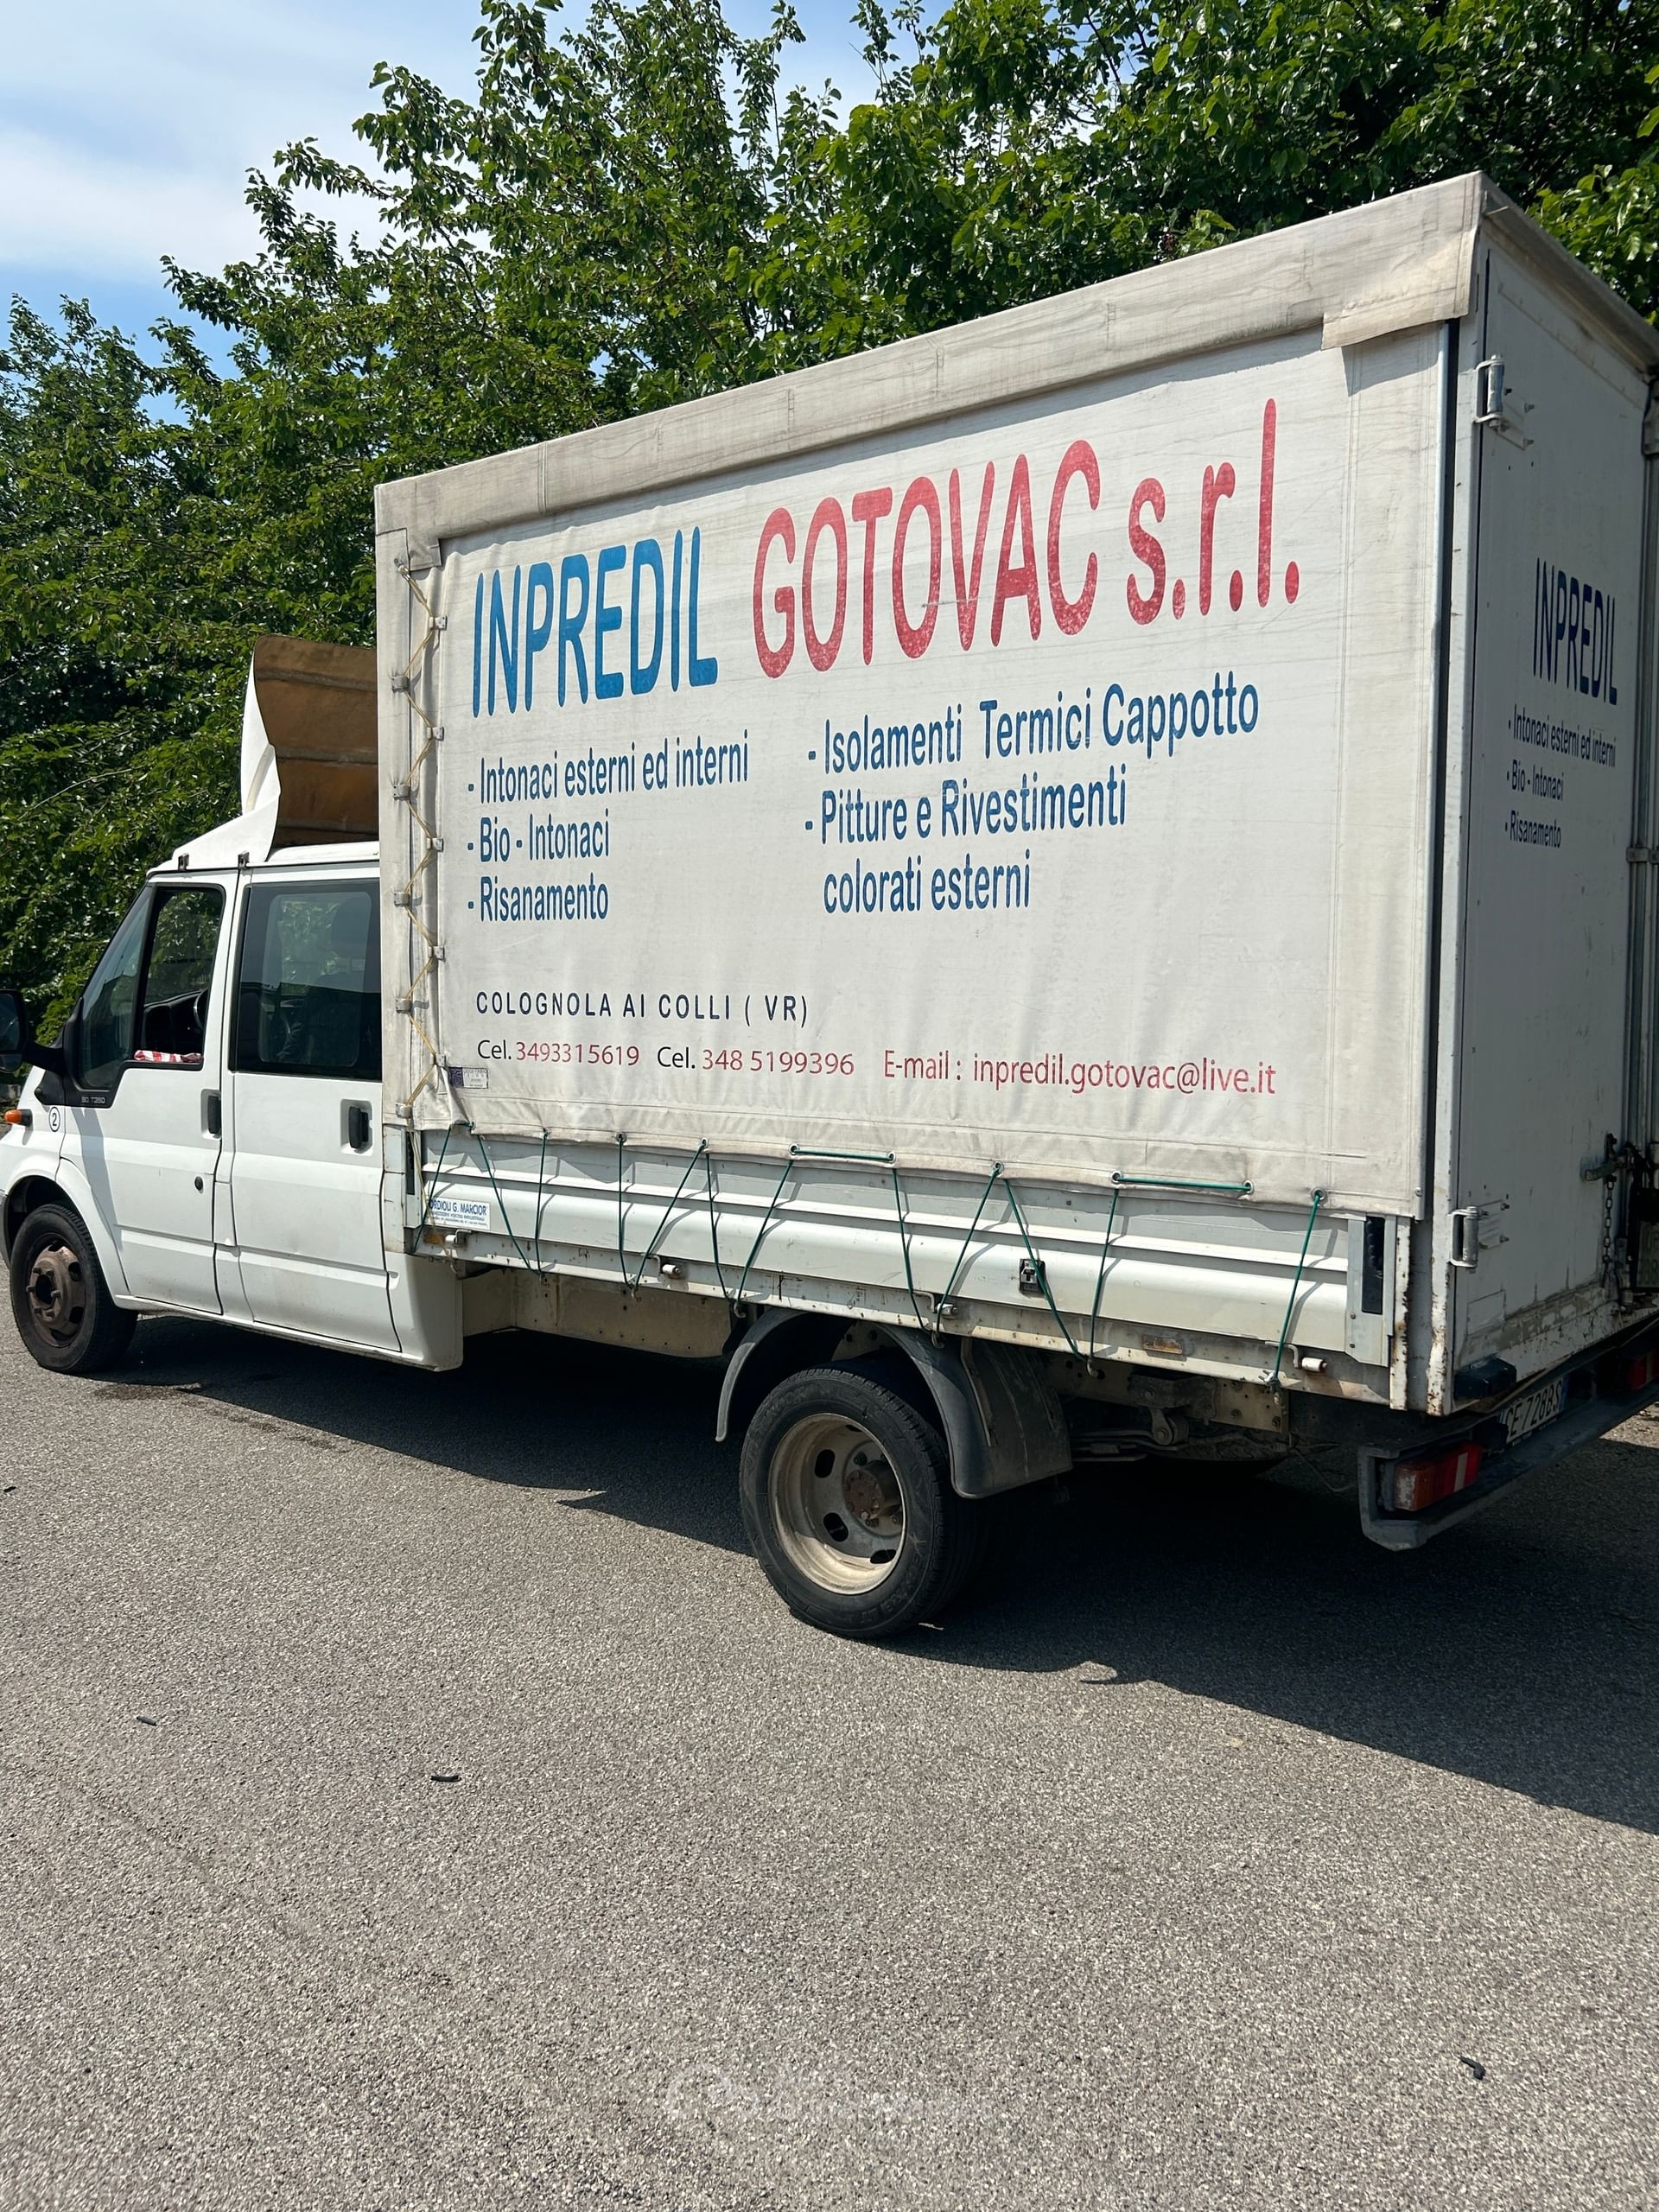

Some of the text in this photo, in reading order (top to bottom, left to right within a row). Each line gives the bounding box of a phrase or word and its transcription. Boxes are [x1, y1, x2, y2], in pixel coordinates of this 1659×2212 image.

[473, 397, 1300, 719] INPREDIL GOTOVAC s.r.l.
[1533, 556, 1618, 707] INPREDIL
[824, 703, 963, 775] Isolamenti
[979, 687, 1092, 760] Termici
[1103, 671, 1260, 759] Cappotto
[1513, 702, 1549, 748] Intonaci
[1550, 719, 1580, 759] esterni
[1581, 729, 1592, 761] ed
[1592, 730, 1617, 768] interni
[480, 749, 558, 804] Intonaci
[564, 741, 635, 797] esterni
[643, 737, 668, 791] ed
[676, 728, 749, 788] interni
[1511, 759, 1527, 793] Bio
[1531, 763, 1565, 803] Intonaci
[821, 787, 908, 845] Pitture
[916, 795, 932, 839] e
[941, 762, 1127, 838] Rivestimenti
[1510, 809, 1562, 850] Risanamento
[480, 816, 511, 862] Bio
[530, 808, 610, 861] Intonaci
[480, 872, 610, 923] Risanamento
[823, 848, 1031, 915] colorati esterni
[476, 991, 612, 1018] COLOGNOLA
[622, 993, 646, 1019] AI
[658, 994, 731, 1020] COLLI
[477, 1039, 855, 1076] Cel. 3493315619 Cel. 348 5199396
[973, 1052, 1277, 1095] inpredil.gotovac@live.it
[52, 1112, 57, 1127] 2
